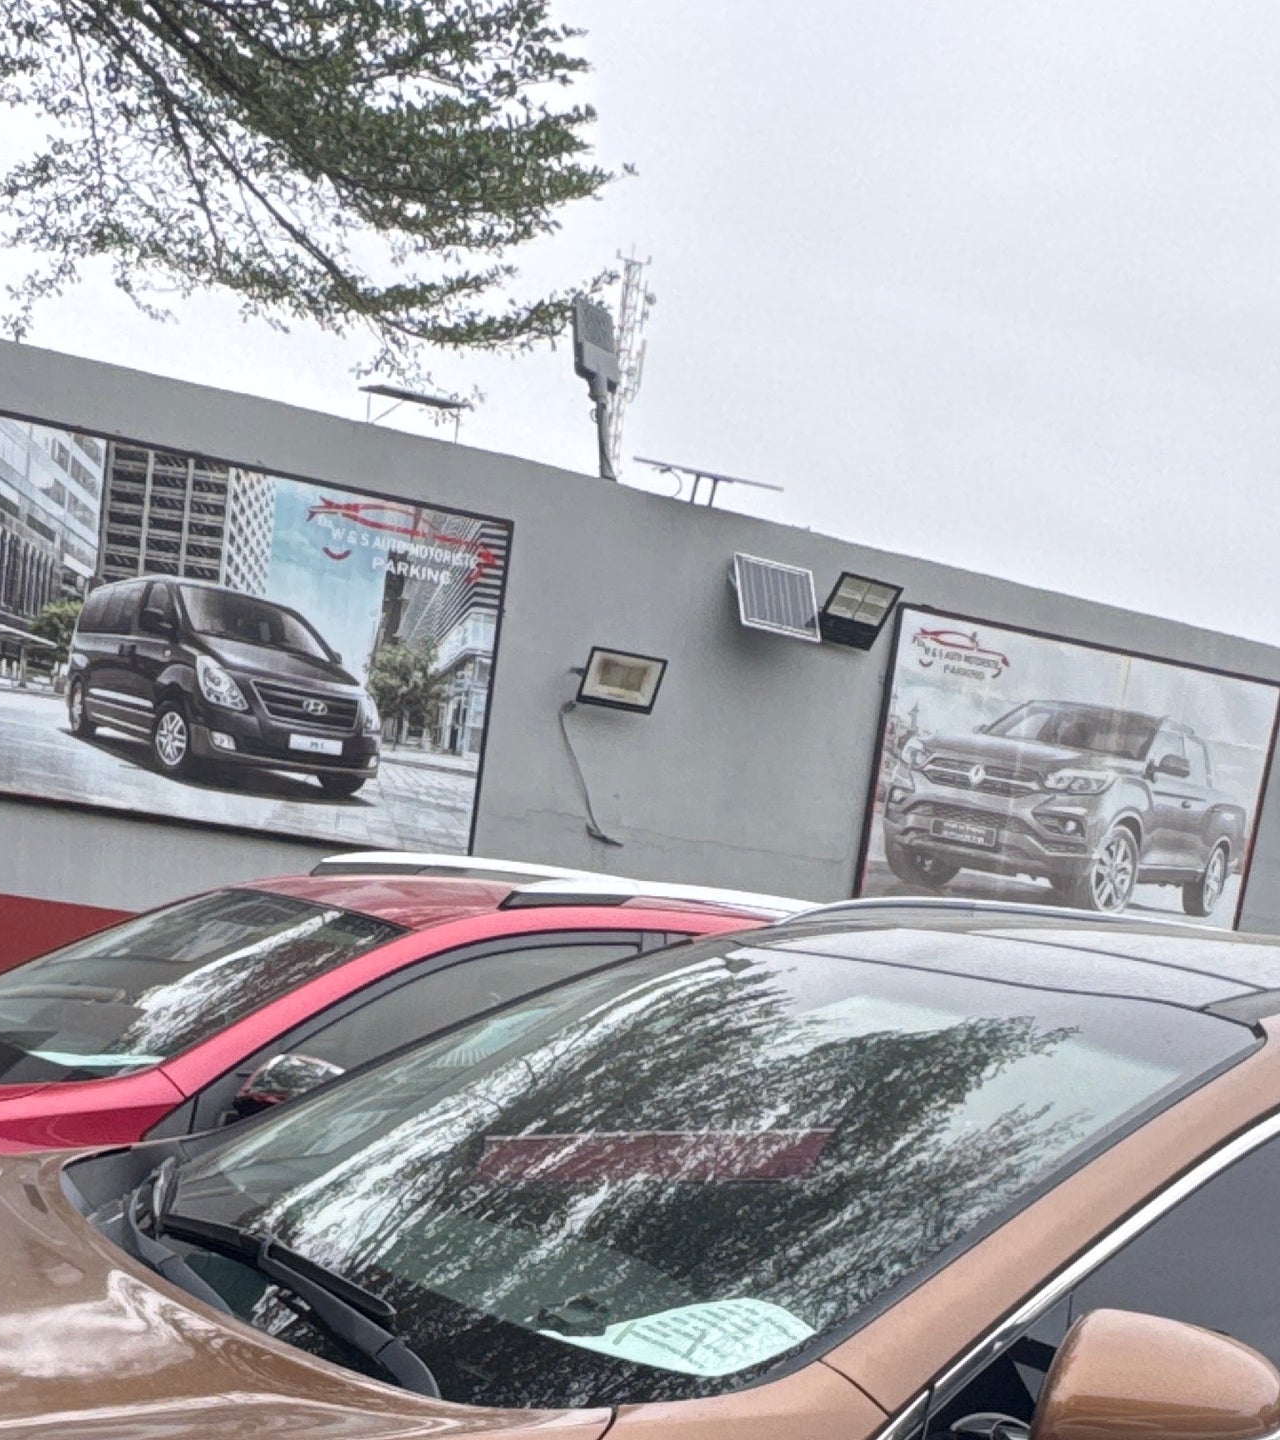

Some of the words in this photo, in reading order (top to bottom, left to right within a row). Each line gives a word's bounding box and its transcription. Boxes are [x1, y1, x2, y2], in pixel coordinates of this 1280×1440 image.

[331, 527, 345, 541] W
[360, 531, 370, 547] S
[372, 535, 408, 554] AUTO
[372, 556, 452, 584] PARKING
